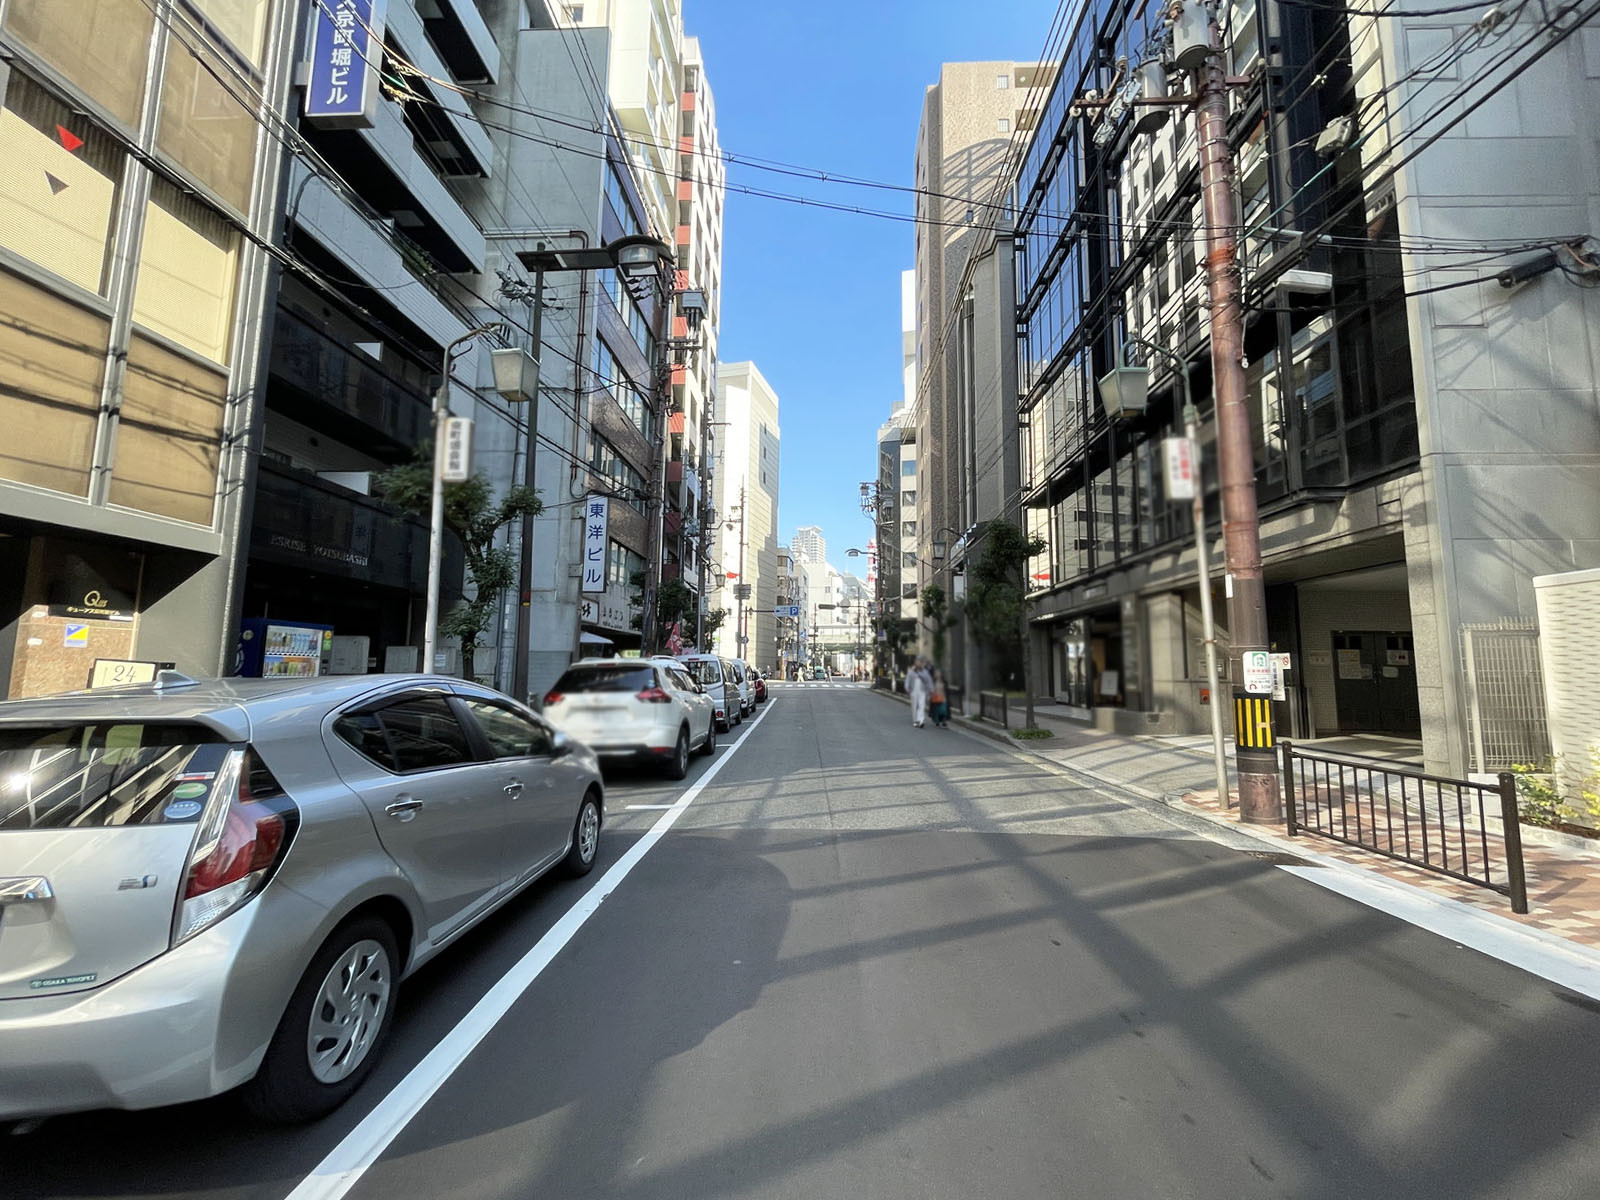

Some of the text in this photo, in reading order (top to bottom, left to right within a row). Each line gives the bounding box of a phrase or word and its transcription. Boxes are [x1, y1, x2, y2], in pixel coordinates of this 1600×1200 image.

[586, 503, 605, 583] 東洋ビル
[113, 665, 136, 682] 24
